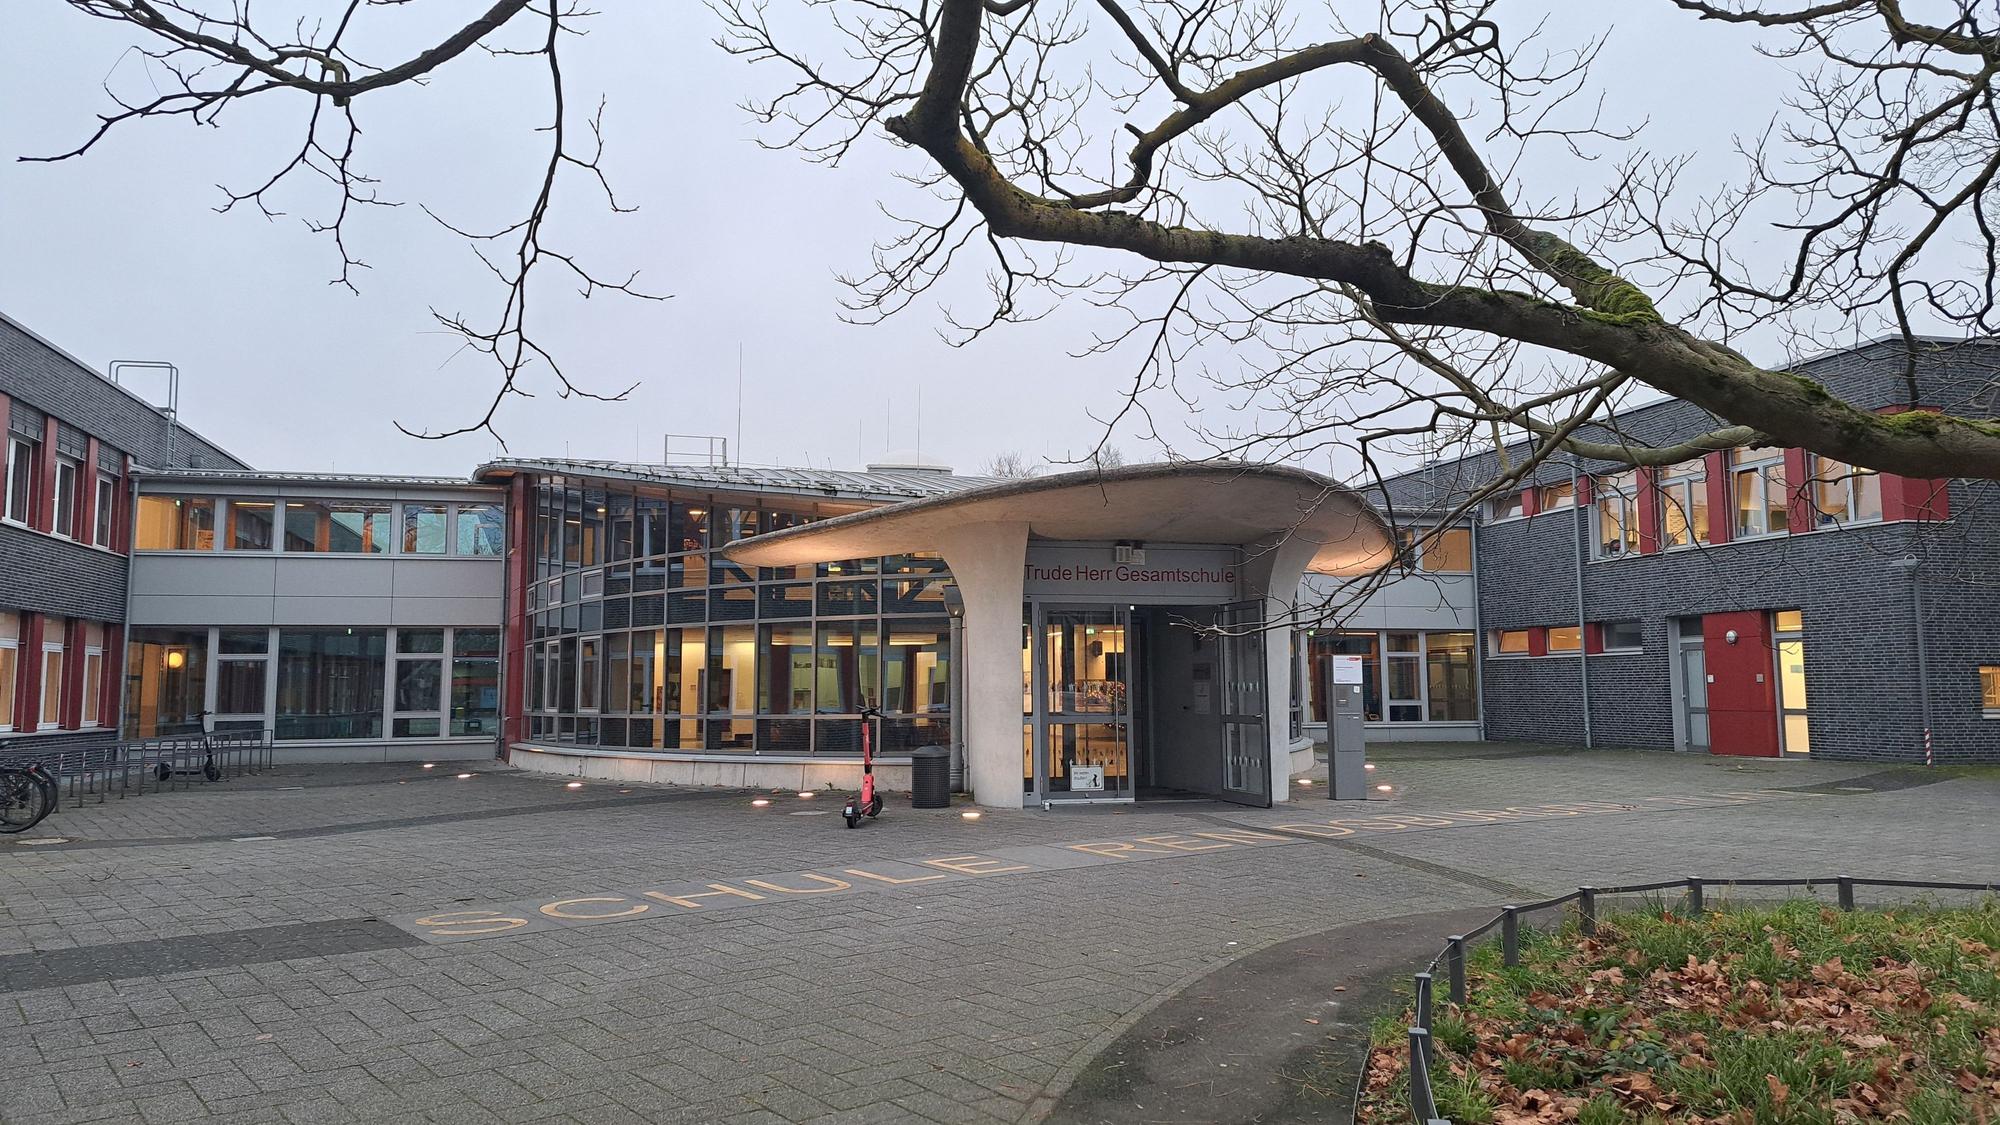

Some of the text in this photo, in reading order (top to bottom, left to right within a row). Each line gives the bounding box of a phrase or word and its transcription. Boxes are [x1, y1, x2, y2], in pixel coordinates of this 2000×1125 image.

[1025, 564, 1235, 583] Trude Herr Gesamtschule
[415, 856, 1030, 935] SCHULE
